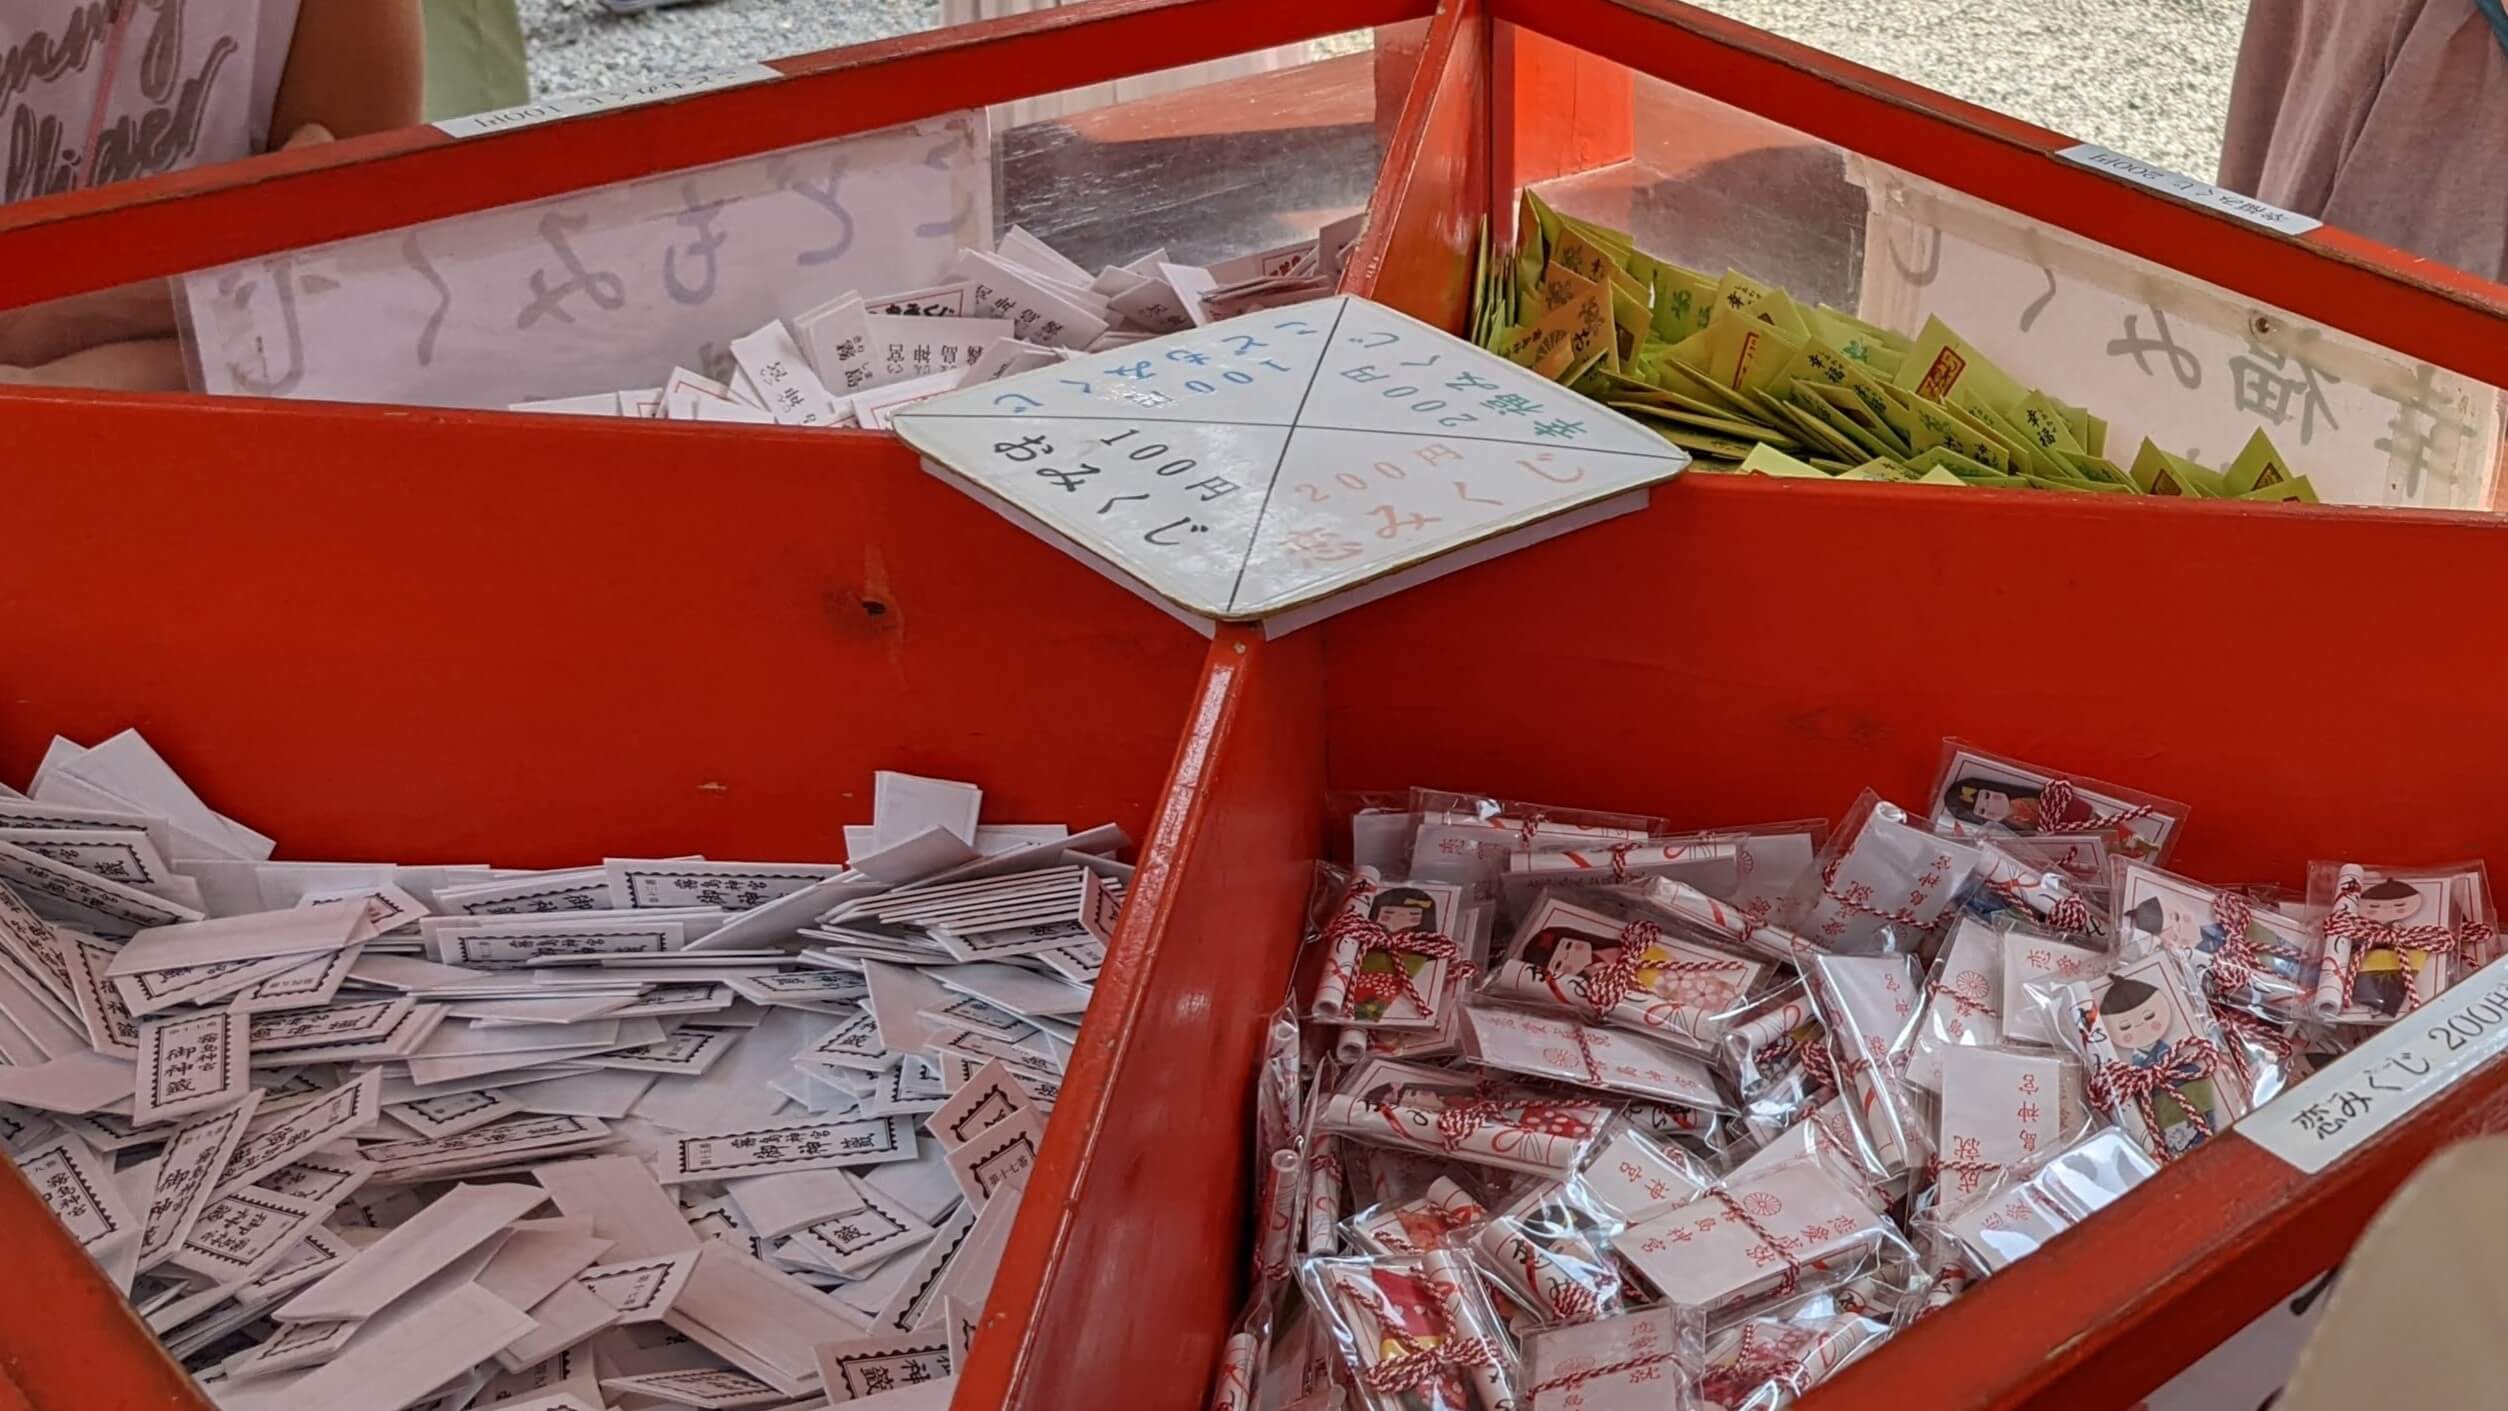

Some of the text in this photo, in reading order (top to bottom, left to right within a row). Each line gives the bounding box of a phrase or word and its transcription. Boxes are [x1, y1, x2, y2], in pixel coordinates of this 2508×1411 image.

[1341, 364, 1479, 428] 200円
[1349, 332, 1587, 439] 幸福みくじ
[994, 434, 1209, 546] おみくじ
[1100, 428, 1241, 502] 100円
[1294, 442, 1465, 503] 200円
[1280, 452, 1585, 568] 恋みくじ
[2291, 1052, 2431, 1141] 恋みくじ
